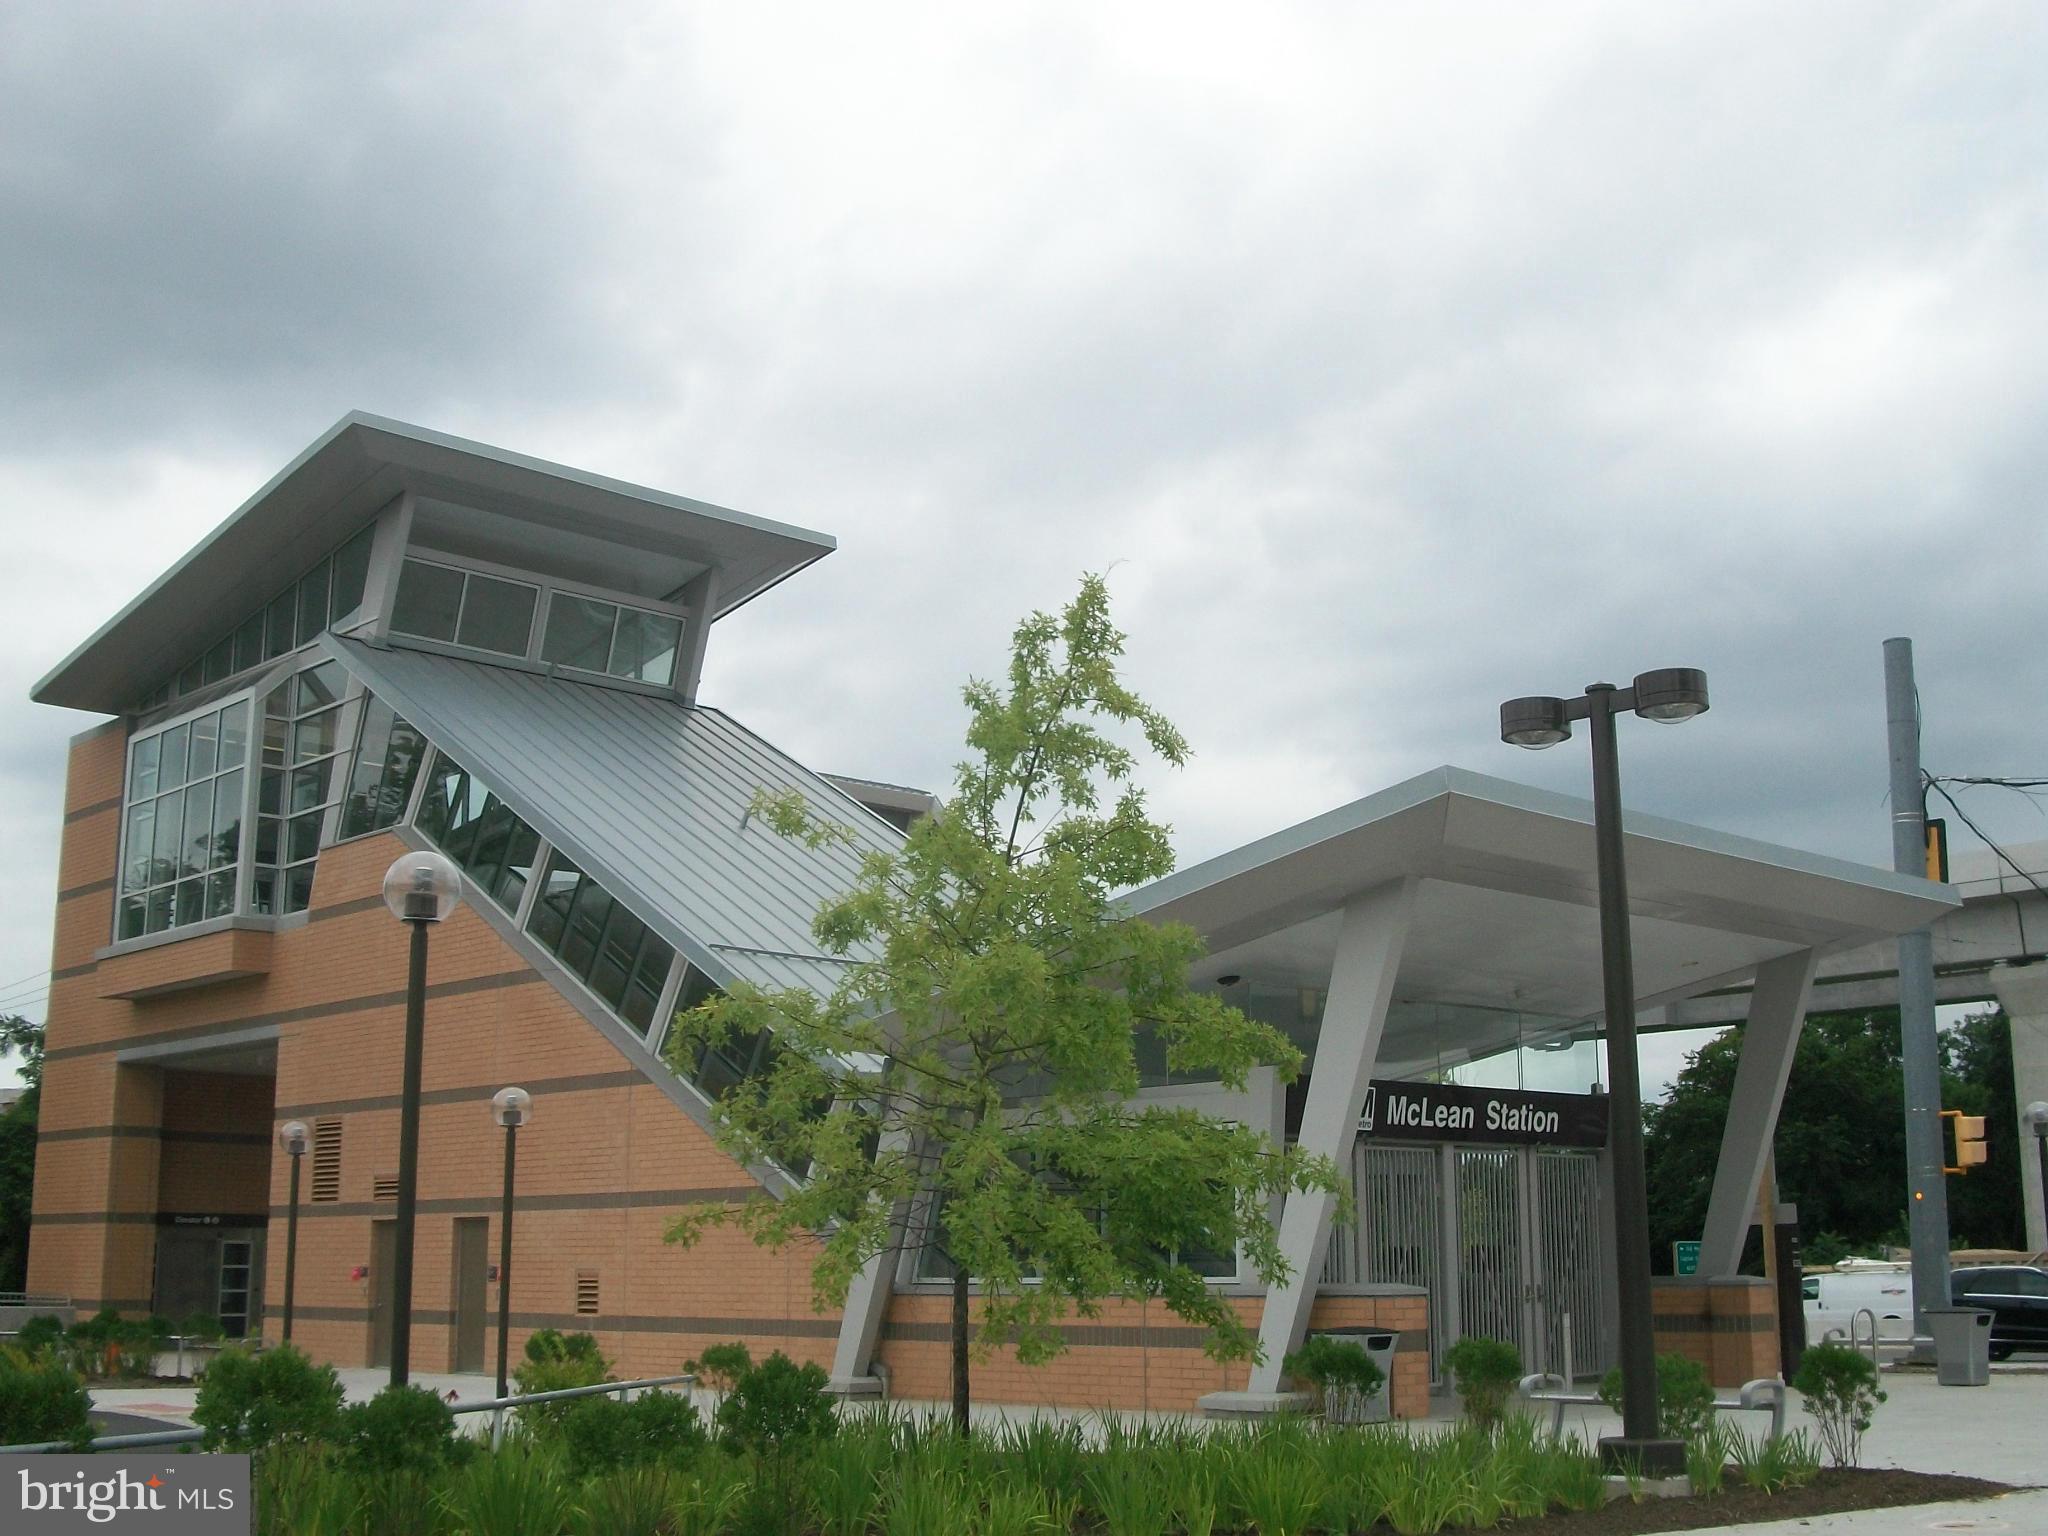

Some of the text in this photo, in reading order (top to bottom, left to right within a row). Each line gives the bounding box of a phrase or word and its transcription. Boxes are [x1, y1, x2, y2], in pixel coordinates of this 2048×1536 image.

[1358, 1120, 1371, 1129] etro
[1387, 1095, 1559, 1133] McLean Station
